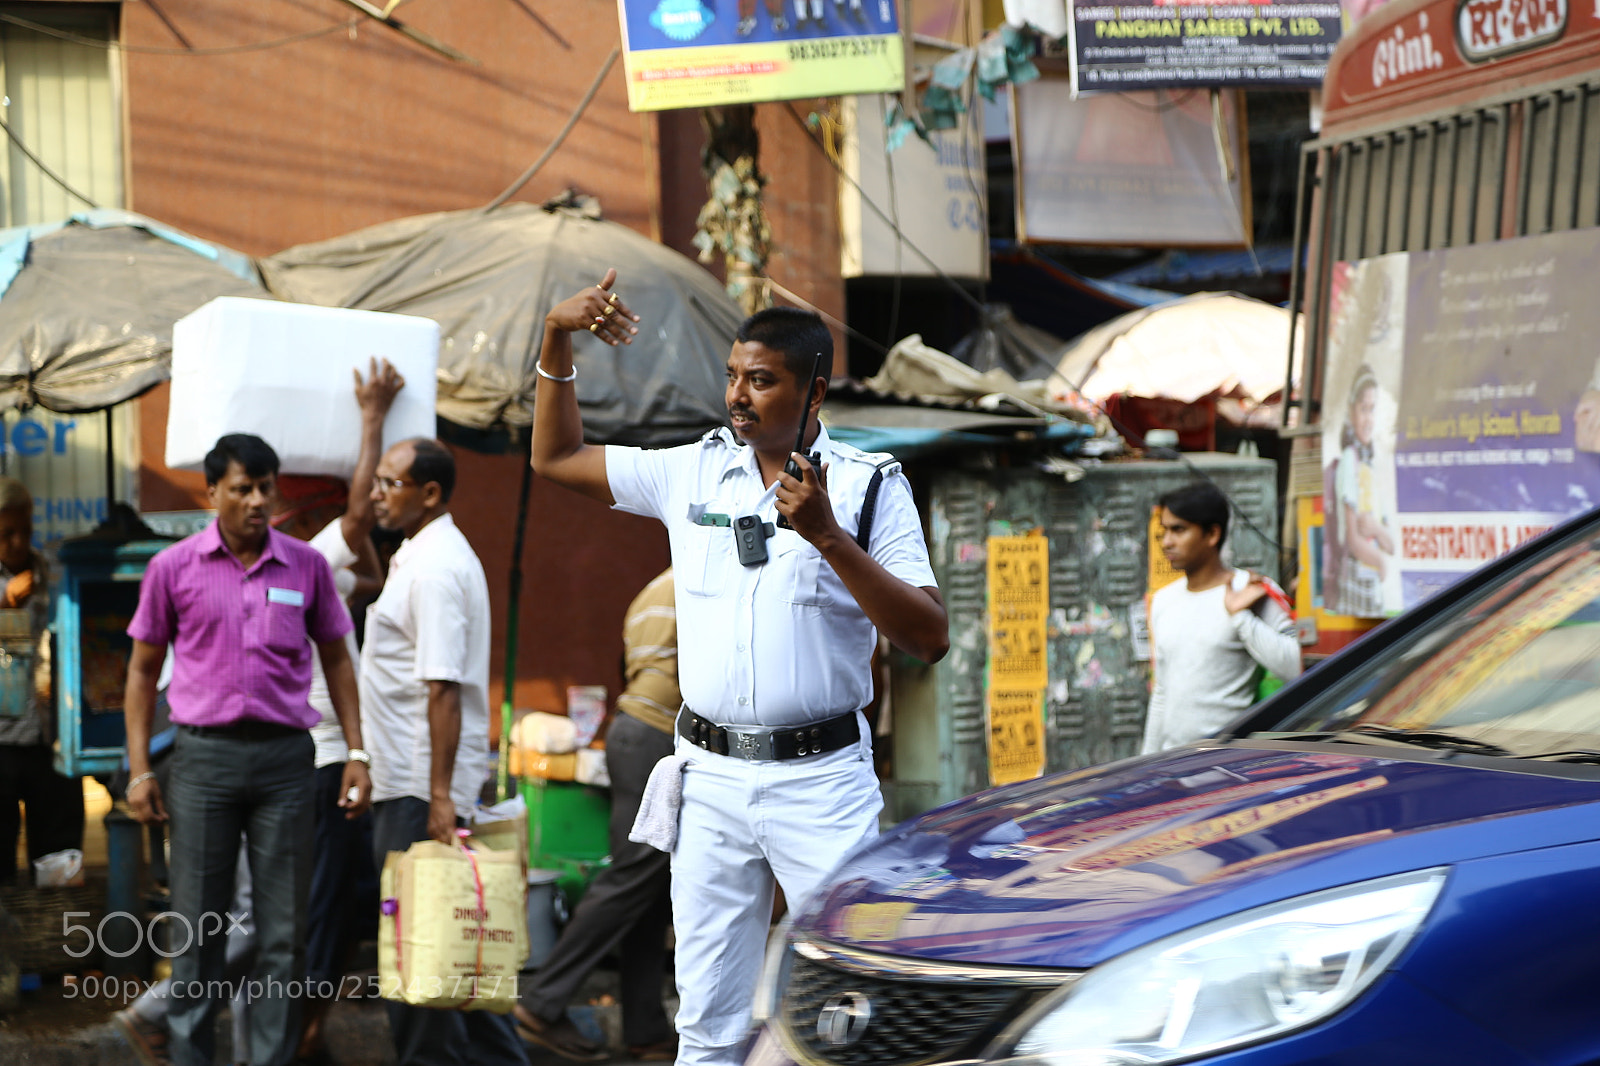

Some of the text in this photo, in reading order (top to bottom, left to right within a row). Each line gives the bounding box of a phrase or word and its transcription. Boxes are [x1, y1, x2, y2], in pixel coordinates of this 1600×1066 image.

[1095, 17, 1325, 39] PANGHAT SAREES PVT. LTD.
[0, 418, 77, 456] er
[1402, 526, 1496, 559] REGISTRATION
